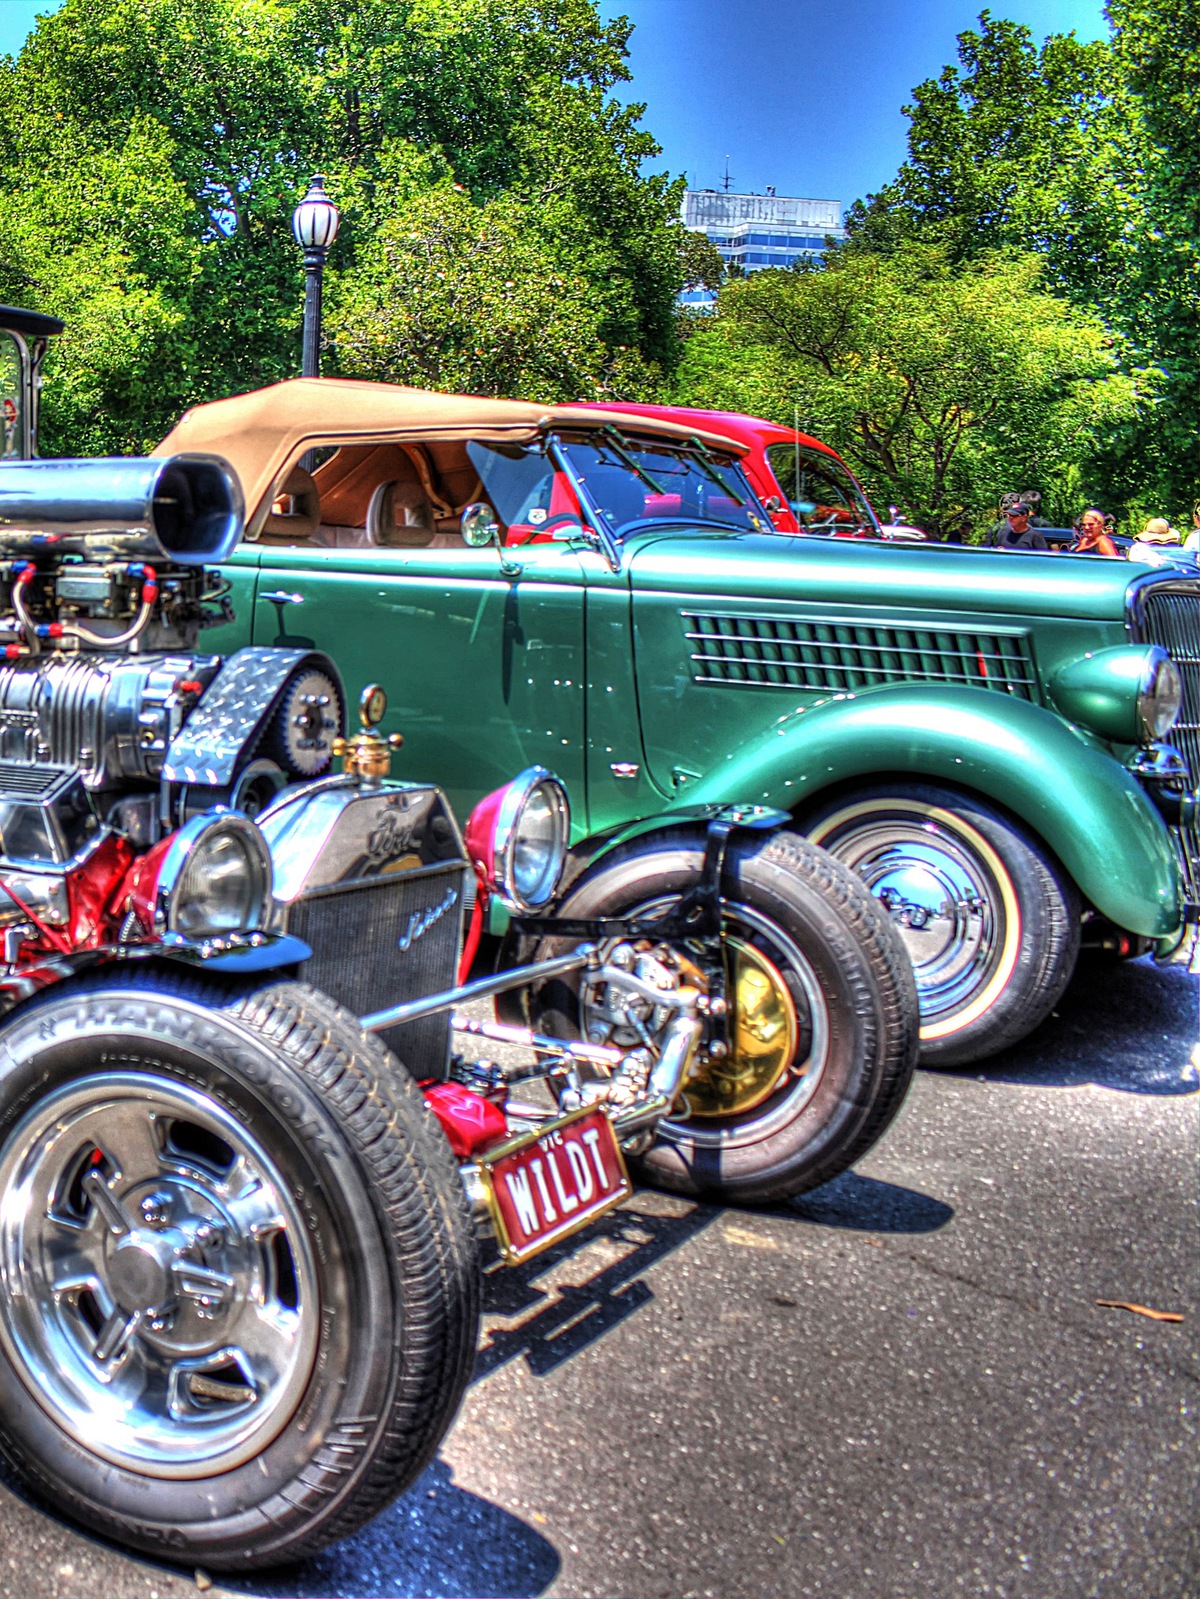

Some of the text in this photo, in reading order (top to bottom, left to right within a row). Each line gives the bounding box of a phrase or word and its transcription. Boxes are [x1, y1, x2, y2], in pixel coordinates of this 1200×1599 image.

[74, 1005, 340, 1158] HANKOOK
[505, 1128, 609, 1236] WILDT
[538, 1130, 563, 1152] VIC
